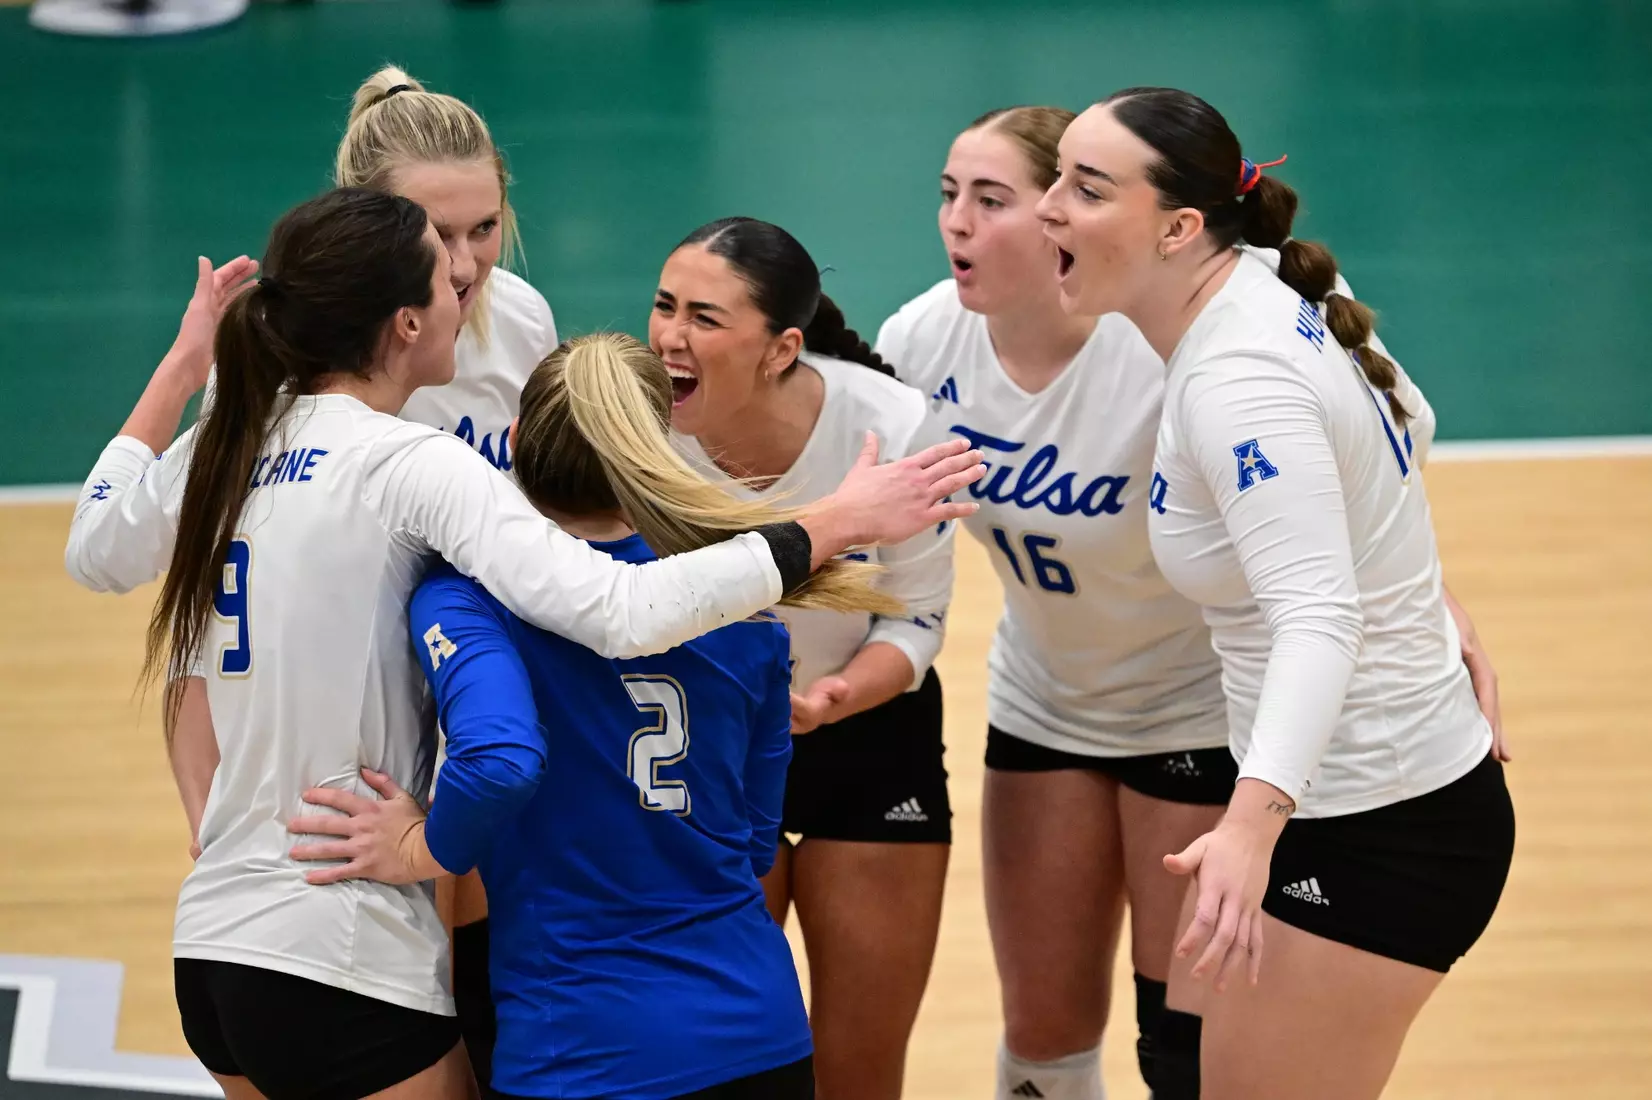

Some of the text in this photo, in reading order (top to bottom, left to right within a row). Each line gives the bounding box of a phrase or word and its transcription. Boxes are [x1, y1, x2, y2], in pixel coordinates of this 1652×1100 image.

[949, 425, 1132, 518] Tulsa
[1232, 439, 1280, 492] A
[212, 533, 255, 680] 9
[991, 526, 1079, 597] 16
[620, 673, 692, 818] 2
